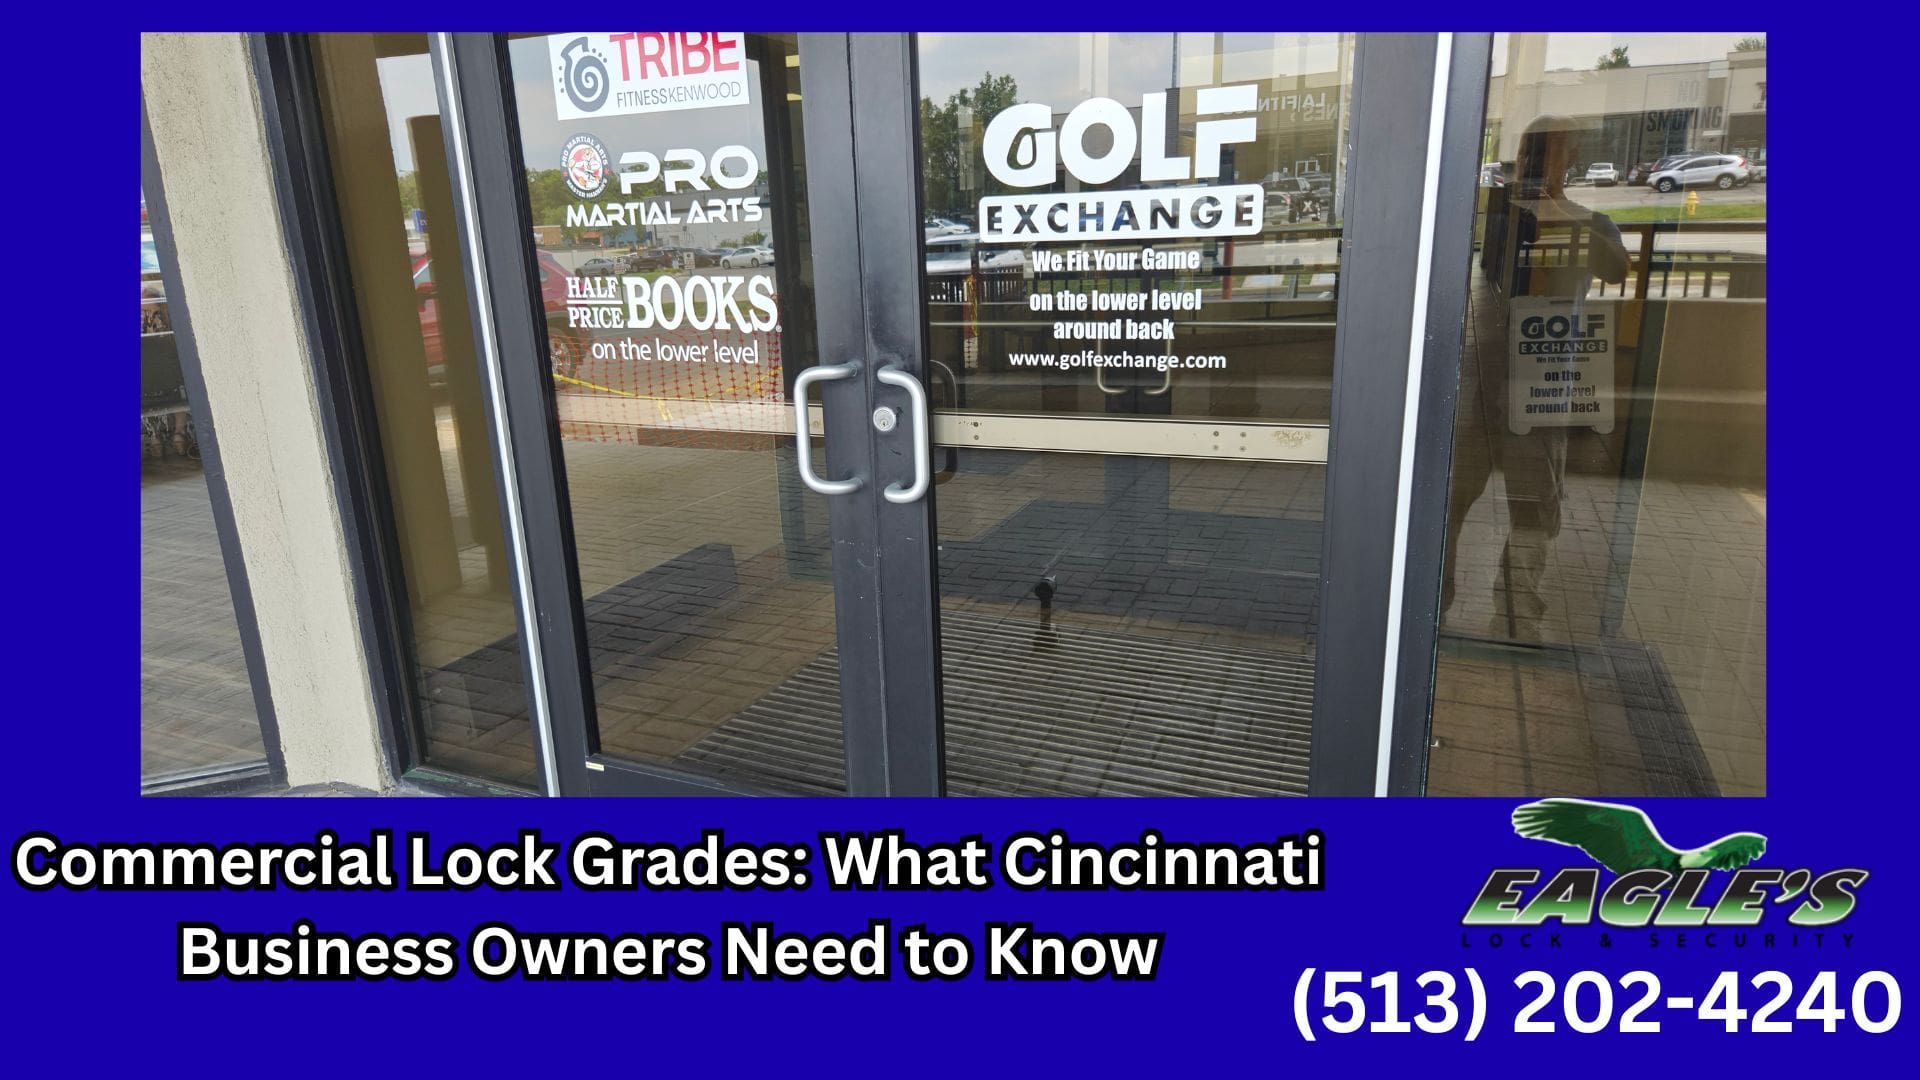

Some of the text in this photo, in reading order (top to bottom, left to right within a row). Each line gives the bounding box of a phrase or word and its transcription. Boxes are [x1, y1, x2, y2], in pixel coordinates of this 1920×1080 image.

[609, 32, 739, 81] TRIBE
[983, 84, 1258, 187] GOLF
[619, 145, 759, 194] PRO
[567, 196, 763, 228] MARTIAL ARTS
[986, 194, 1255, 235] EXCHANGE
[1032, 248, 1200, 272] We Fit Your Game
[566, 275, 778, 334] HALF BOOKS
[1029, 289, 1202, 311] on the lower level
[567, 306, 624, 329] PRICE
[1053, 318, 1175, 340] around back
[1521, 314, 1605, 339] GOLF
[592, 337, 759, 364] on the lower level
[1521, 342, 1606, 353] EXCHANGE
[1009, 350, 1227, 372] www.golfexchange.com
[1544, 369, 1581, 382] on the
[1530, 385, 1596, 398] lower level
[1526, 401, 1600, 414] around back
